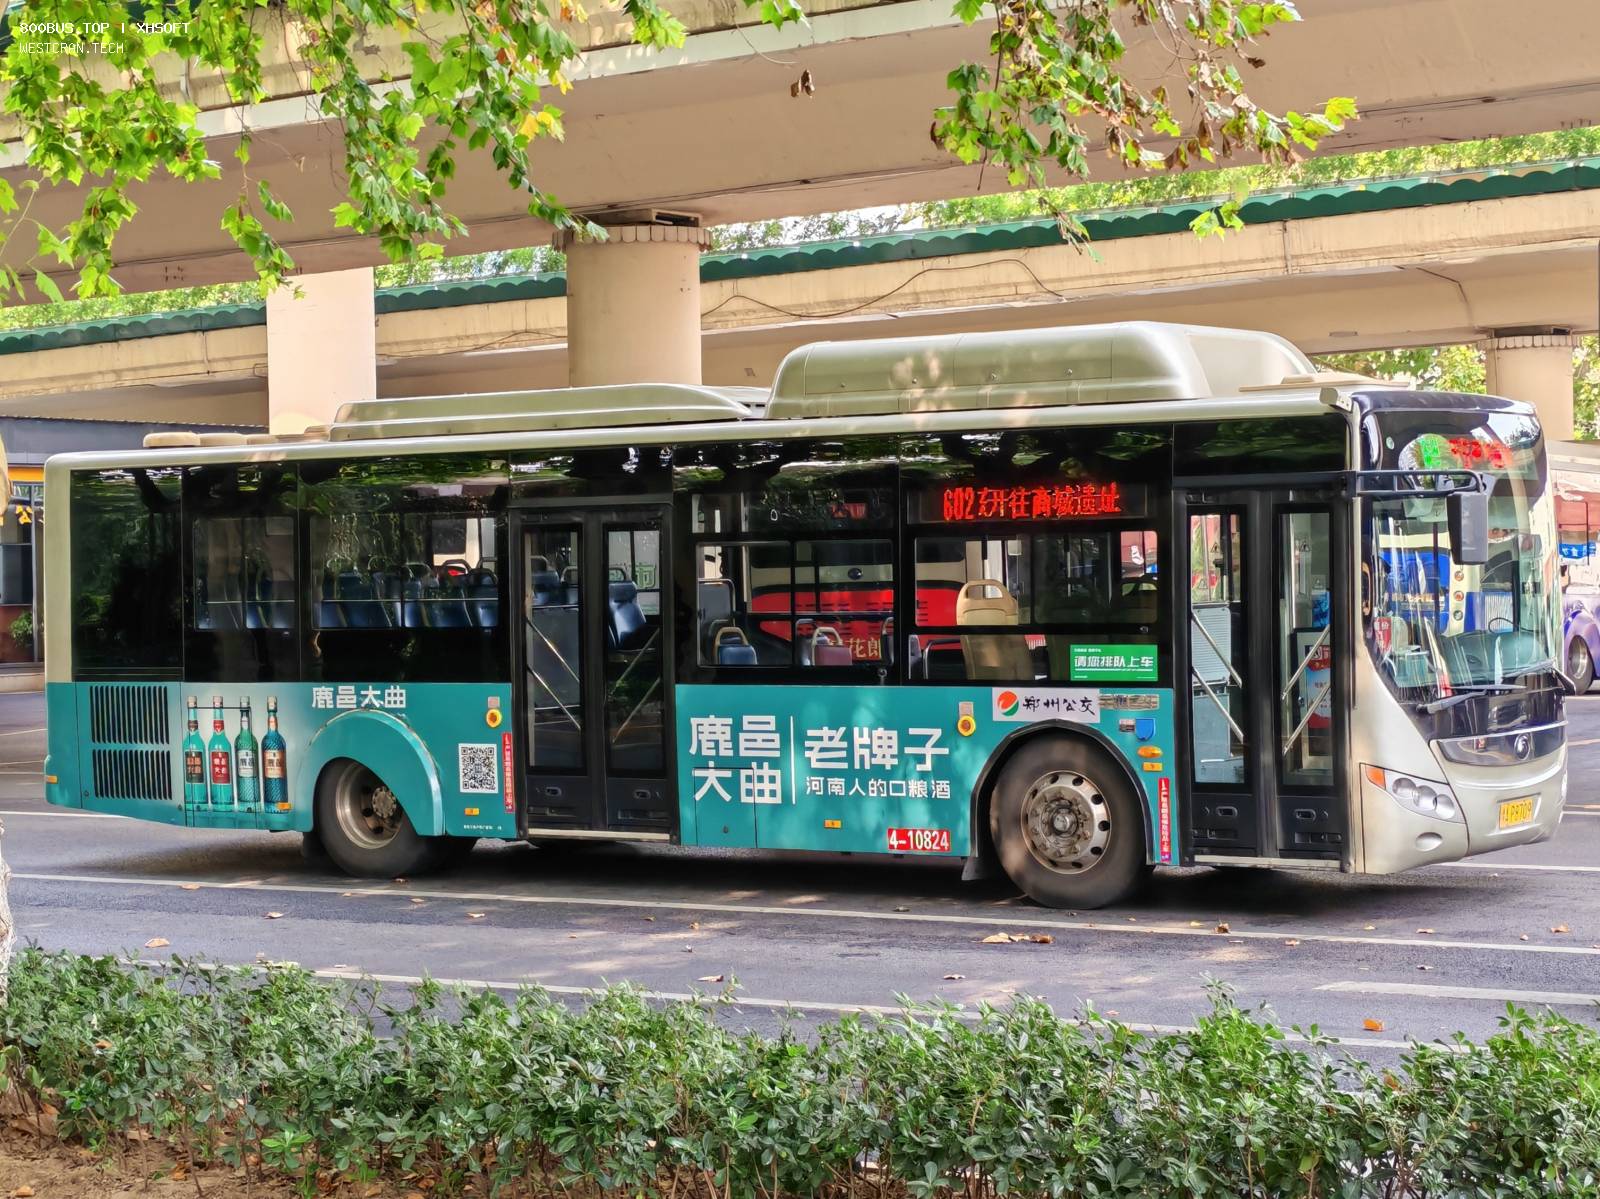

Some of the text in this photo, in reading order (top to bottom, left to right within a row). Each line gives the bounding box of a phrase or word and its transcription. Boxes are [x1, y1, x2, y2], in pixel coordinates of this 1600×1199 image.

[1074, 655, 1154, 668] 请您排队上车
[312, 685, 406, 708] 鹿邑大曲
[1023, 696, 1096, 716] 郑州公交
[689, 714, 781, 758] 鹿邑
[804, 726, 949, 772] 老牌子
[692, 761, 782, 804] 大曲
[805, 776, 951, 799] 河南人的口粮酒
[889, 830, 950, 851] 4-10824
